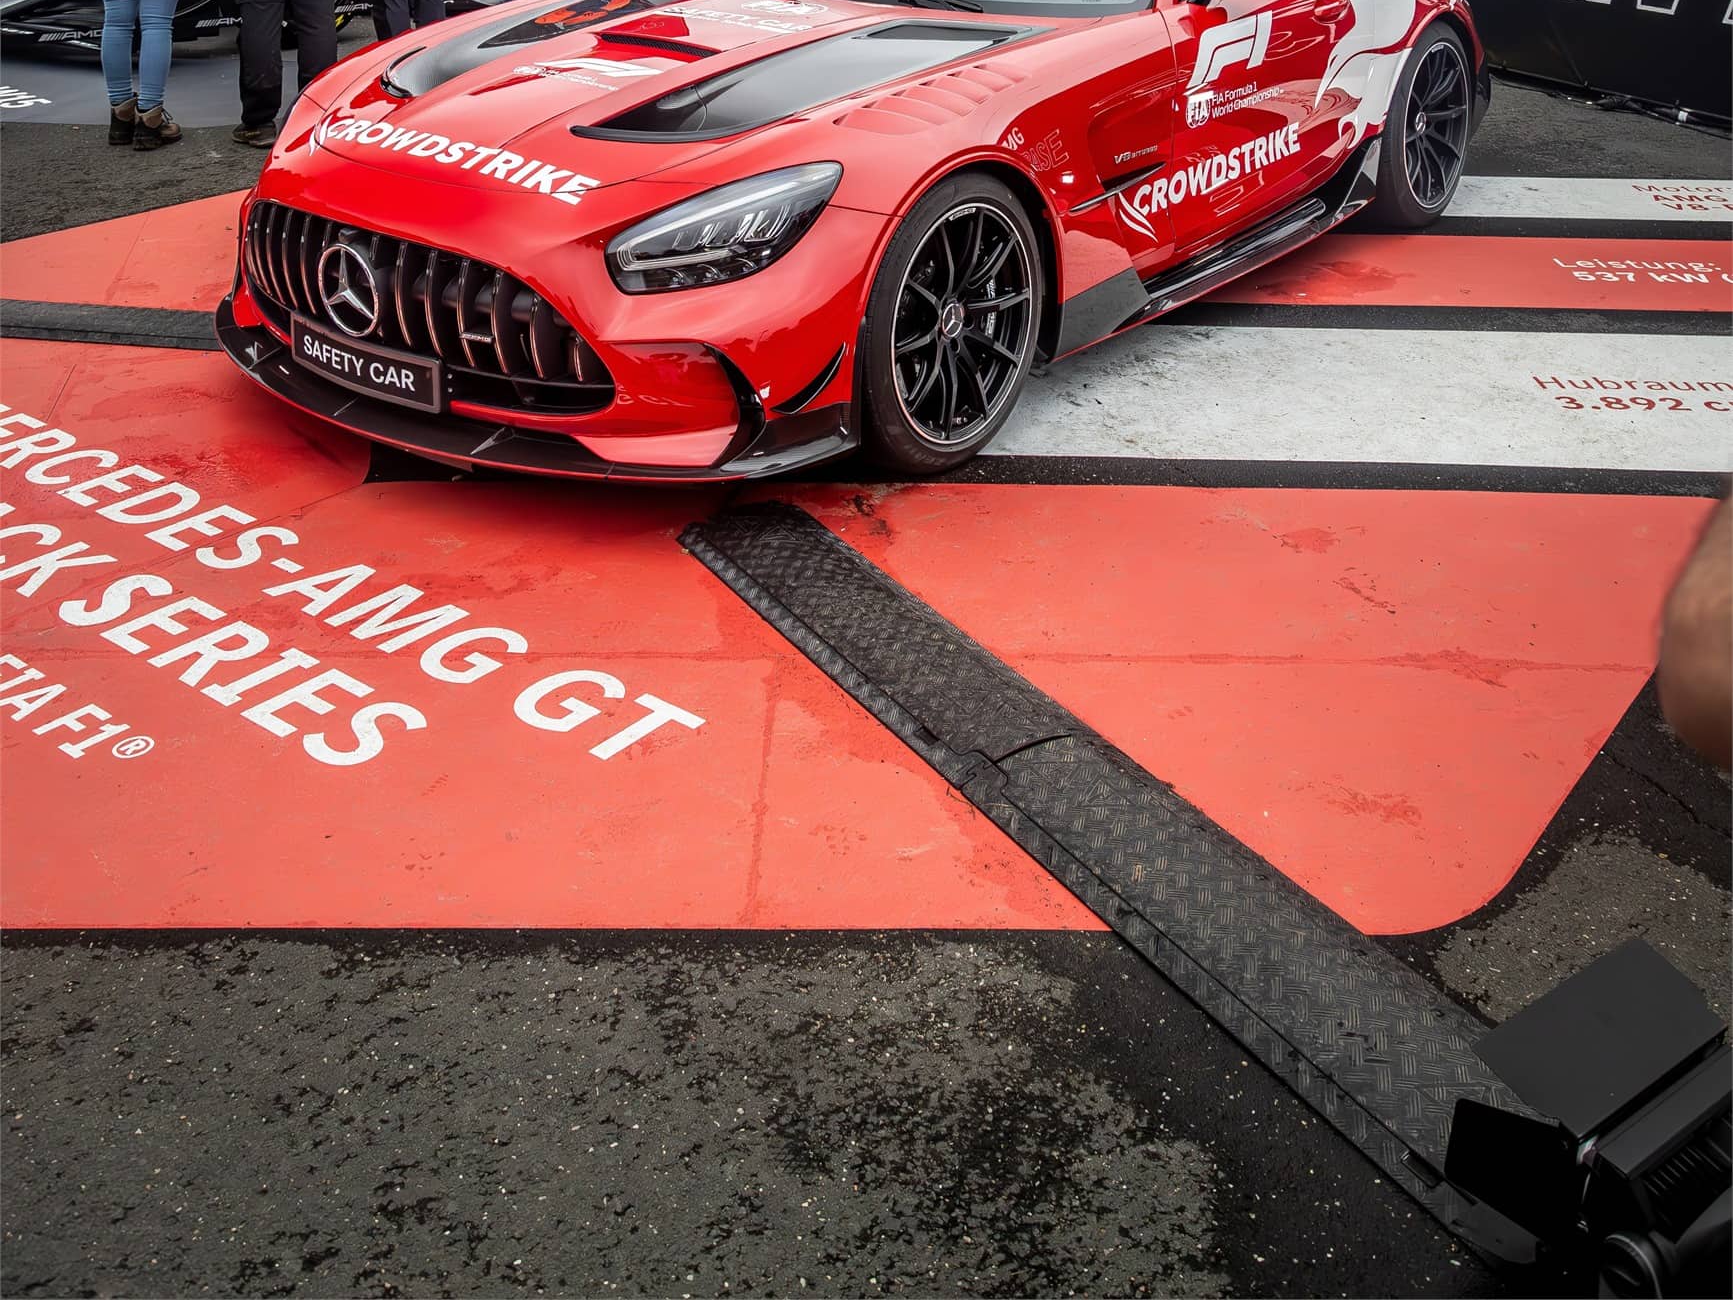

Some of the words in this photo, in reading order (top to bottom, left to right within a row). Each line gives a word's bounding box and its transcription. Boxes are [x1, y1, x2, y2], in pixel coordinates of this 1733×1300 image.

[1210, 93, 1225, 106] FIA
[1225, 84, 1253, 102] Formula
[1253, 81, 1258, 92] 1
[1211, 102, 1233, 119] World
[1233, 87, 1280, 110] Championship
[327, 118, 601, 206] CROWDSTRIKE
[1114, 151, 1131, 165] V8
[1132, 121, 1301, 217] CROWDSTRIKE
[1652, 194, 1729, 202] AMG
[1552, 258, 1722, 273] Leistung:
[1572, 271, 1637, 282] 537
[1647, 272, 1710, 284] kW
[303, 334, 365, 377] SAFETY
[369, 362, 416, 392] CAR
[1555, 396, 1693, 412] 3.892
[0, 502, 119, 598] CK
[0, 404, 528, 684] RCEDES-AMG
[513, 670, 706, 761] GT
[58, 574, 427, 766] SERIES
